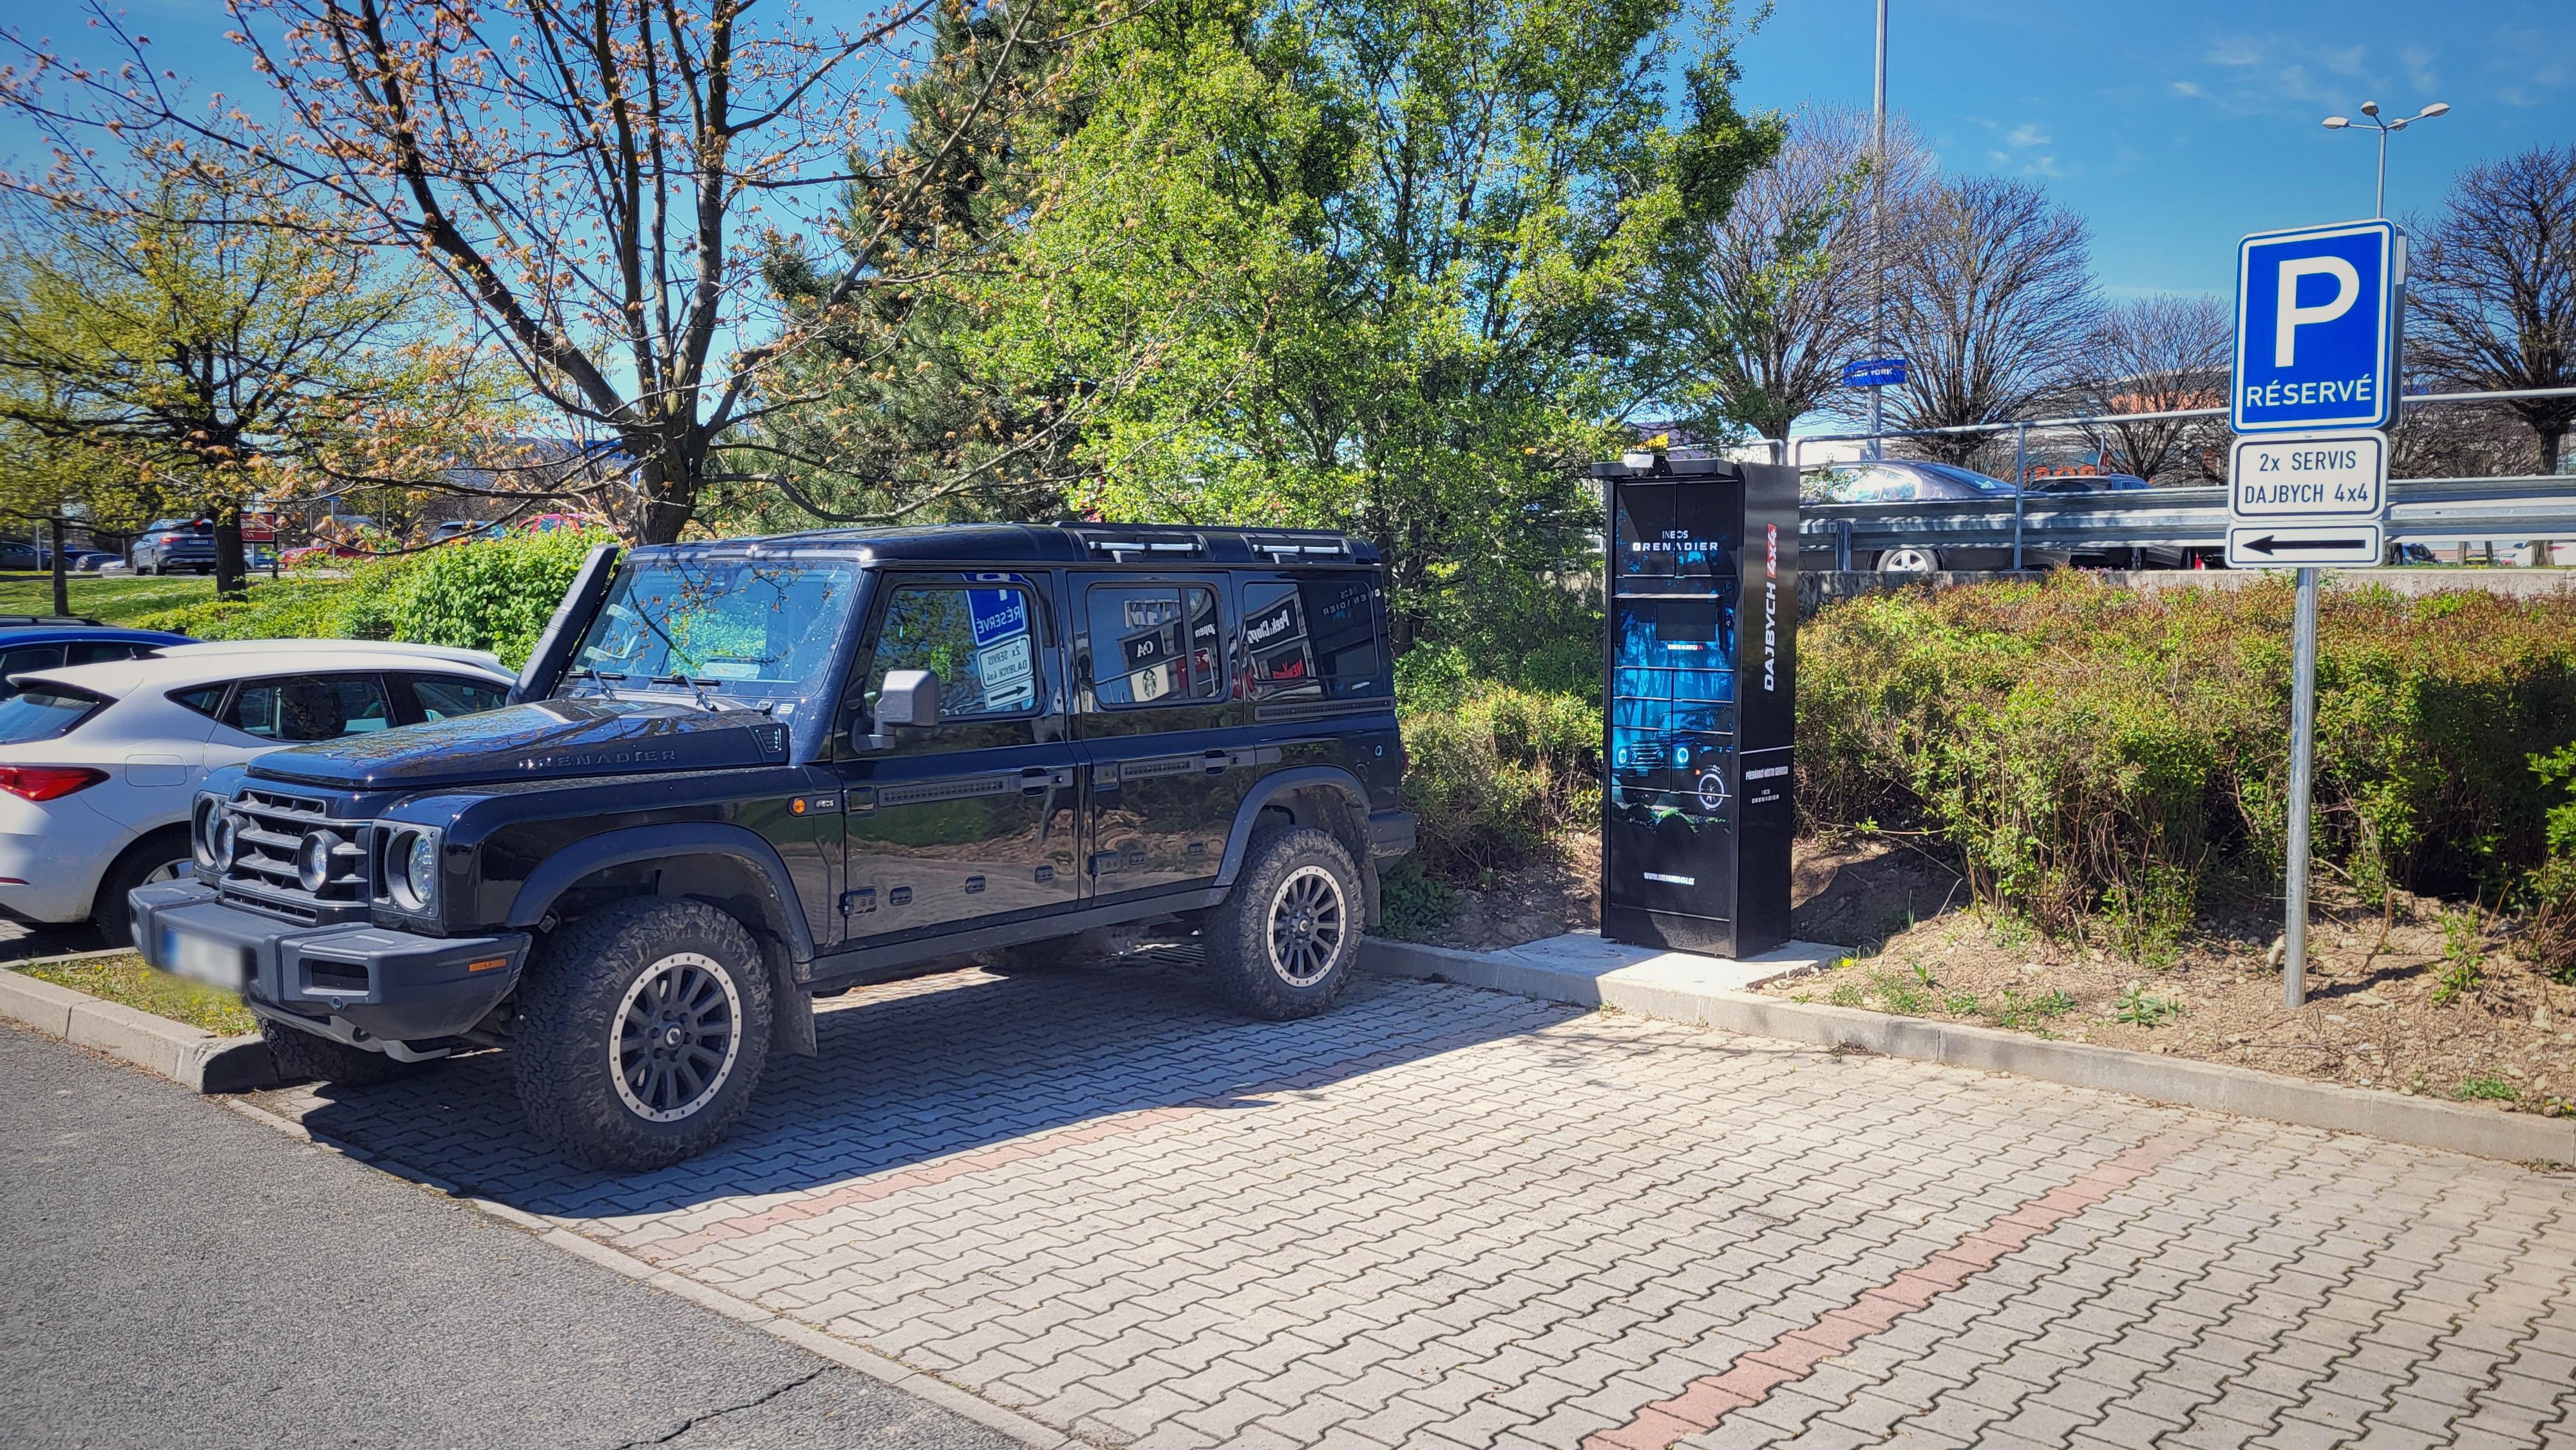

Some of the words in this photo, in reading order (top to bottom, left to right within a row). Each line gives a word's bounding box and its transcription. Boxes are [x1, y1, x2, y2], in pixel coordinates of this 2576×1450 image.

[2275, 256, 2360, 368] P
[1870, 368, 1893, 376] YORK
[2246, 373, 2372, 408] RÉSERVÉ
[2259, 453, 2280, 472] 2x
[2291, 450, 2356, 471] SERVIS
[2244, 484, 2324, 504] DAJBYCH
[2334, 482, 2368, 502] 4x4
[1662, 530, 1689, 540] INEOS
[1633, 541, 1718, 552] GRENADIER
[1764, 581, 1777, 692] DAJBYCH
